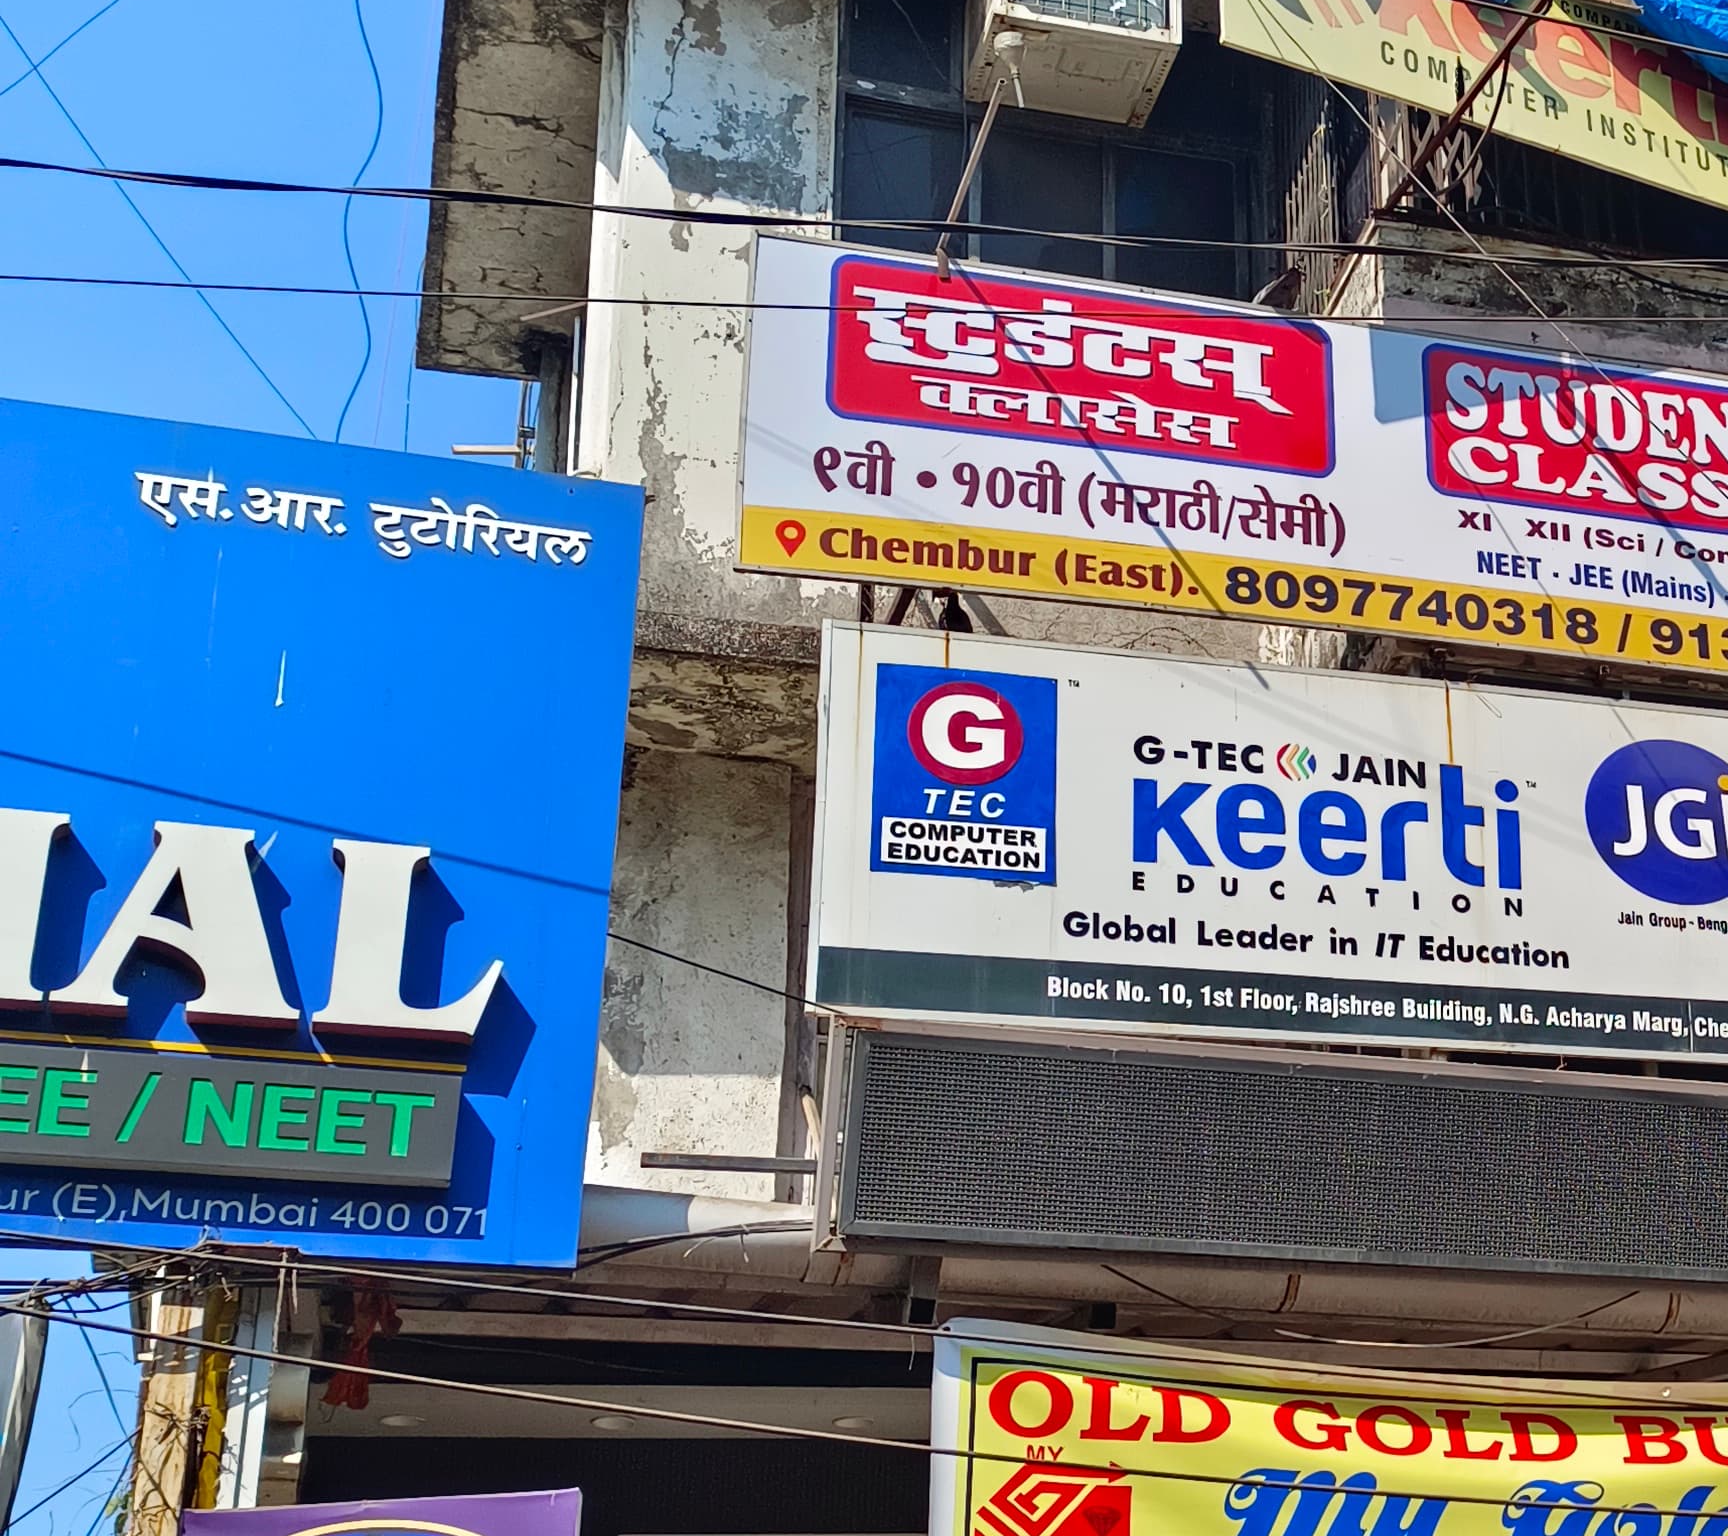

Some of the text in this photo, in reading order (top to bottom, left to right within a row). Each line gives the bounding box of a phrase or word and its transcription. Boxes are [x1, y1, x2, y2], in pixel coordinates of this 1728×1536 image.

[909, 373, 1240, 451] क्लासेस
[370, 496, 594, 567] टुटोरियल
[1078, 470, 1348, 559] (मराठी/सेमी)
[1457, 509, 1494, 533] XI
[1525, 516, 1572, 544] XII
[819, 526, 1037, 579] Chembur
[1053, 548, 1201, 598] (East).
[1224, 565, 1600, 647] 8097740318
[1476, 549, 1542, 581] NEET
[1568, 559, 1615, 591] JEE
[1621, 568, 1716, 608] (Mains)
[921, 694, 1006, 769] G
[1331, 752, 1428, 790] JAIN
[888, 821, 1038, 848] COMPUTER
[923, 788, 1007, 820] TEC
[885, 843, 1042, 871] EDUCATION
[1131, 871, 1525, 918] EDUCATION
[1062, 910, 1571, 971] Global Leader in IT Education
[1046, 975, 1110, 1004] Block
[1113, 979, 1152, 1005] No.
[1158, 983, 1194, 1011] 10,
[1199, 984, 1234, 1009] 1st
[1240, 986, 1301, 1015] Floor,
[1304, 992, 1396, 1021] Rajshree
[1401, 997, 1494, 1028] Building,
[1498, 1002, 1541, 1027] N.G.
[1545, 1005, 1626, 1035] Acharya
[1631, 1009, 1690, 1039] Marg,
[182, 1078, 436, 1158] NEET
[329, 1199, 488, 1236] 400 071
[987, 1369, 1232, 1447] OLD
[1273, 1399, 1580, 1467] GOLD
